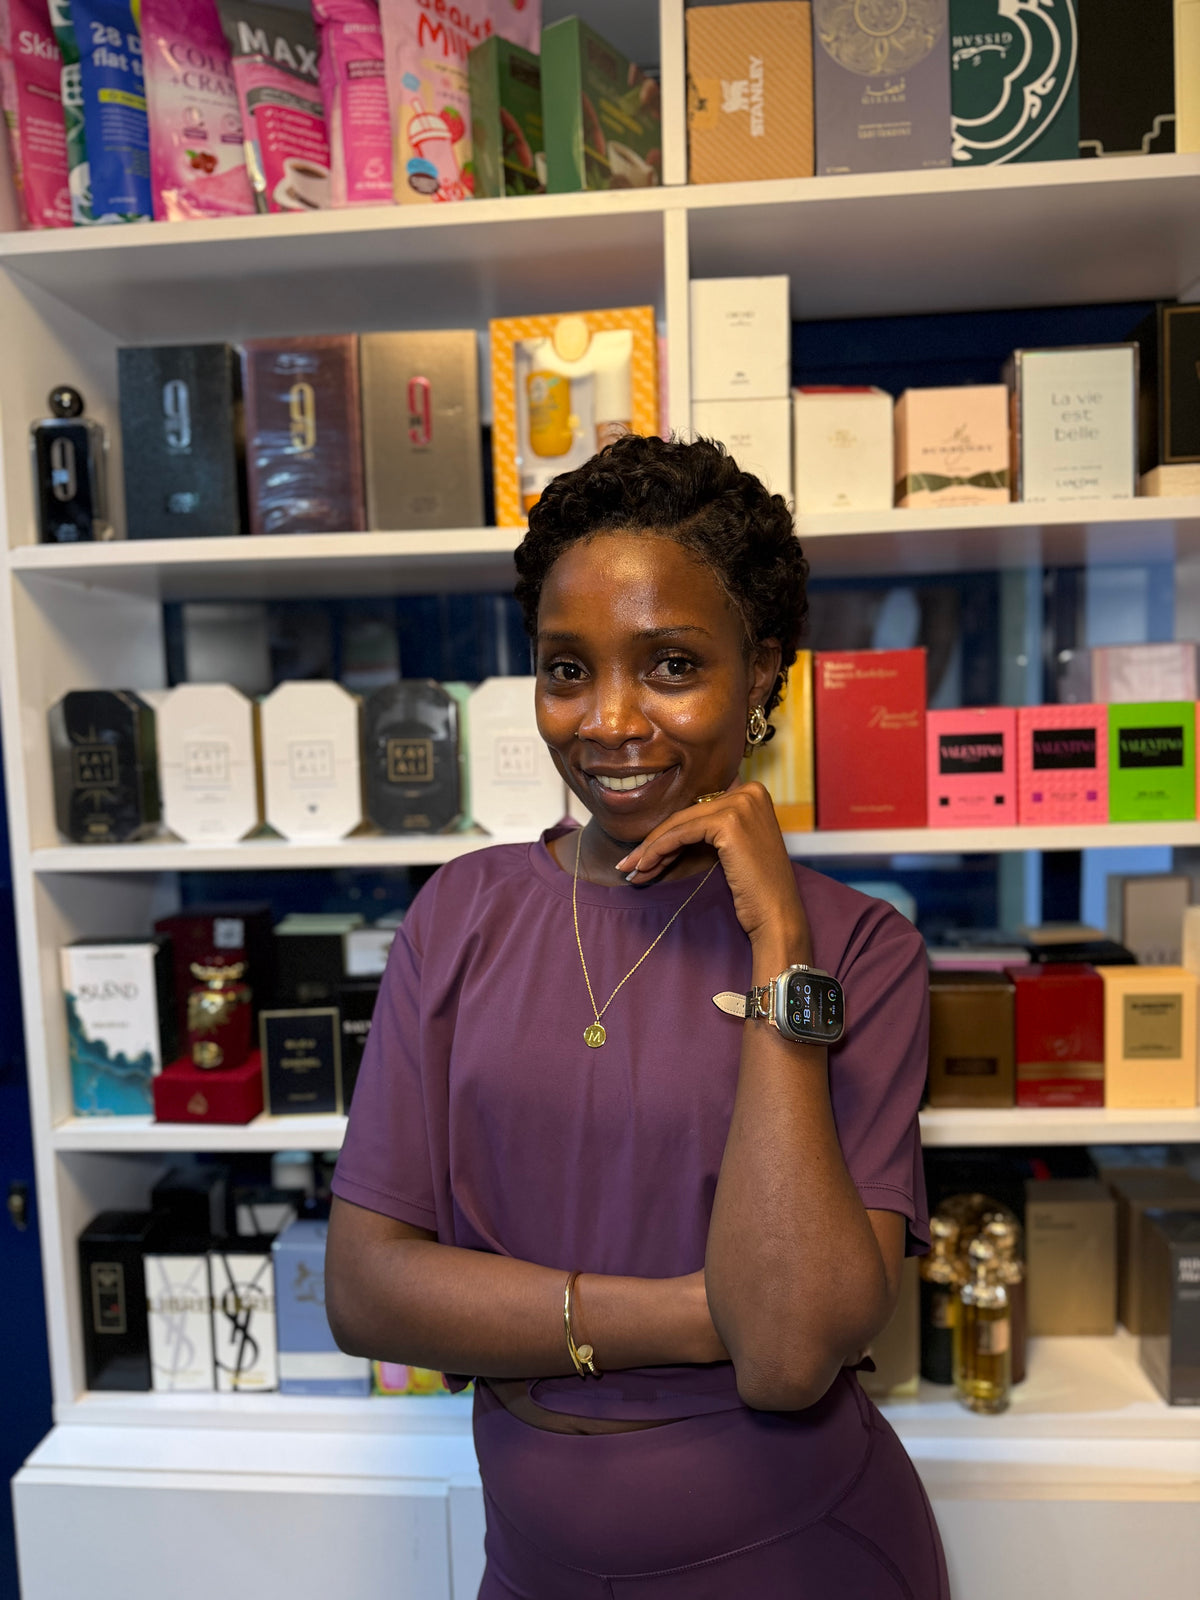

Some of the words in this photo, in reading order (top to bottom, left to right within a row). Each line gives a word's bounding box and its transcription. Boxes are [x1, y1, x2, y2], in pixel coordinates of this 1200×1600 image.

[90, 21, 122, 47] 28
[93, 46, 128, 72] flat
[238, 21, 320, 77] MAX
[749, 56, 764, 137] STANLEY
[1076, 390, 1102, 405] vie
[1061, 409, 1092, 422] est
[1054, 427, 1099, 442] belle
[940, 744, 1003, 758] VALENTINO
[803, 985, 812, 1025] 18:40
[588, 1030, 601, 1043] M
